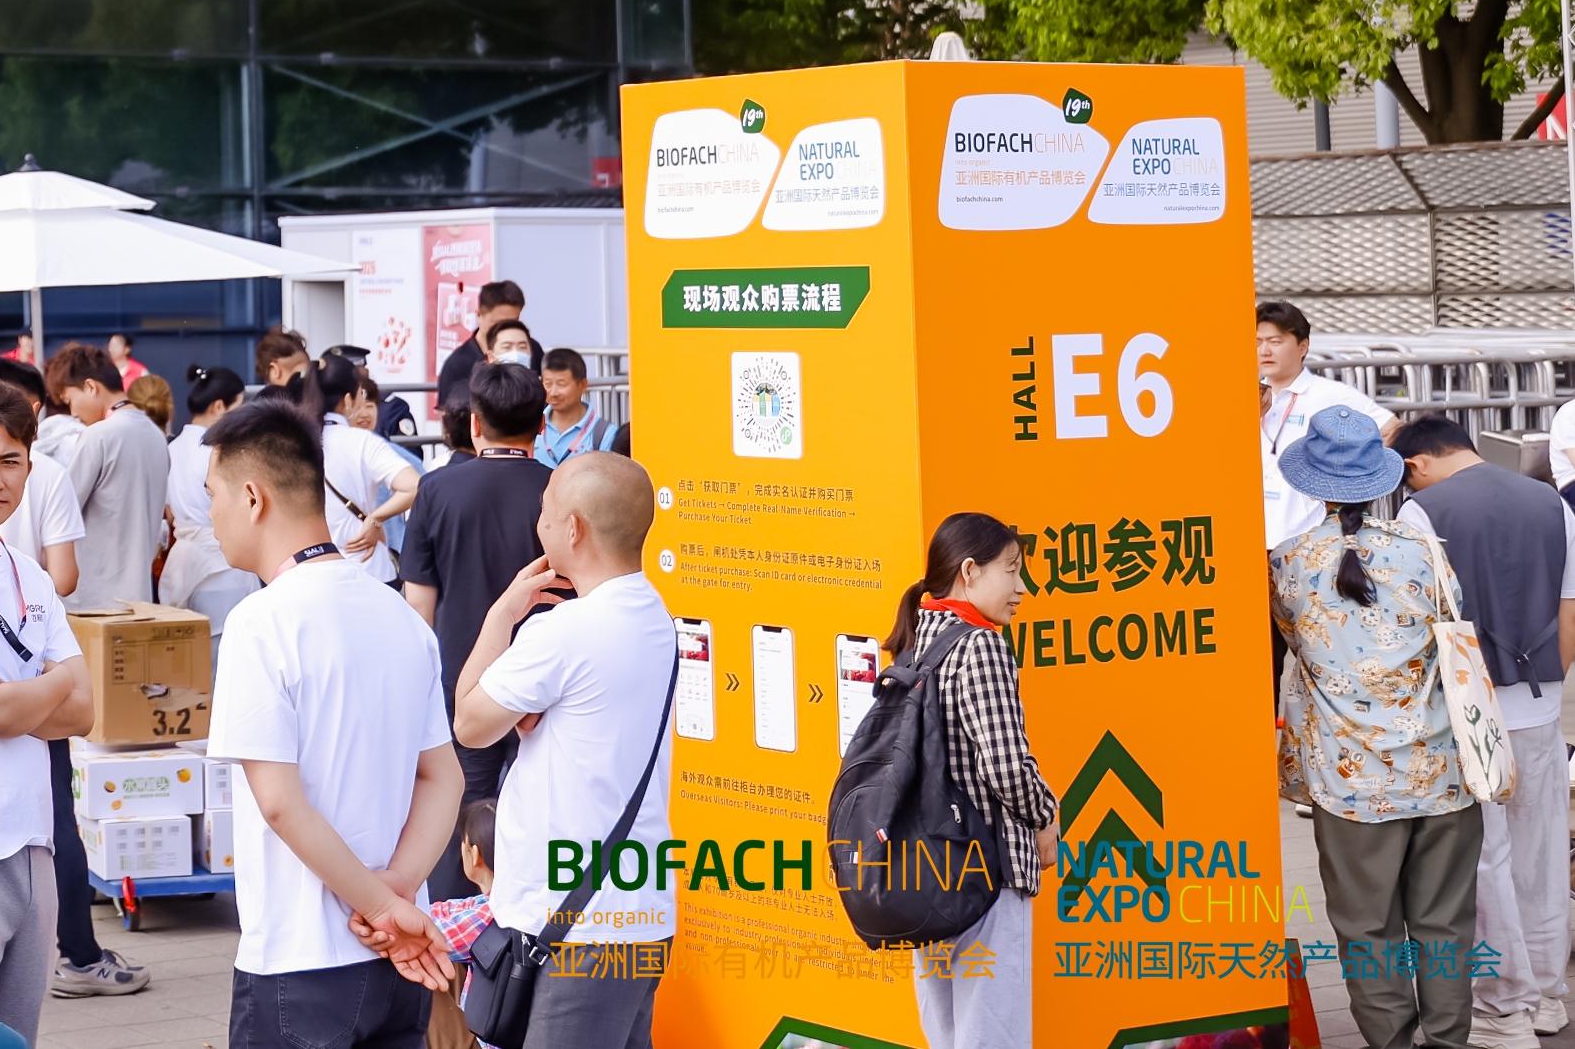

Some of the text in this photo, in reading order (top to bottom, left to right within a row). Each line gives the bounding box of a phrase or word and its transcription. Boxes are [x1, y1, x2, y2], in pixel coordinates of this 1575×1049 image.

[798, 140, 860, 161] NATURAL
[1131, 138, 1200, 156] NATURAL
[955, 170, 1086, 186] 亚洲国际有机产品博览会
[1103, 182, 1221, 197] 亚洲国际天然产品博览会
[682, 283, 842, 312] 现场观众购票流程
[1011, 336, 1038, 441] HALL
[1051, 332, 1174, 439] E6
[659, 491, 671, 505] 01
[678, 498, 691, 507] Get
[692, 499, 717, 509] Tickets
[726, 501, 761, 513] Complete
[804, 506, 847, 518] Verification
[678, 511, 752, 525] Purchase Your Ticket
[661, 554, 673, 567] 02
[680, 562, 883, 589] After ticket purchase: Scan ID card or electronic credential
[680, 576, 753, 592] at the gate for entry.
[152, 708, 191, 736] 3.2
[680, 789, 827, 826] Overseas Visitors: Please print your badg
[684, 902, 698, 914] This
[698, 907, 733, 922] exhibition
[734, 914, 740, 923] is
[747, 918, 790, 934] professional
[791, 927, 818, 941] organic
[684, 916, 721, 933] exclusively
[723, 924, 731, 934] to
[733, 926, 762, 942] industry
[684, 929, 697, 939] and
[808, 958, 844, 973] restricted
